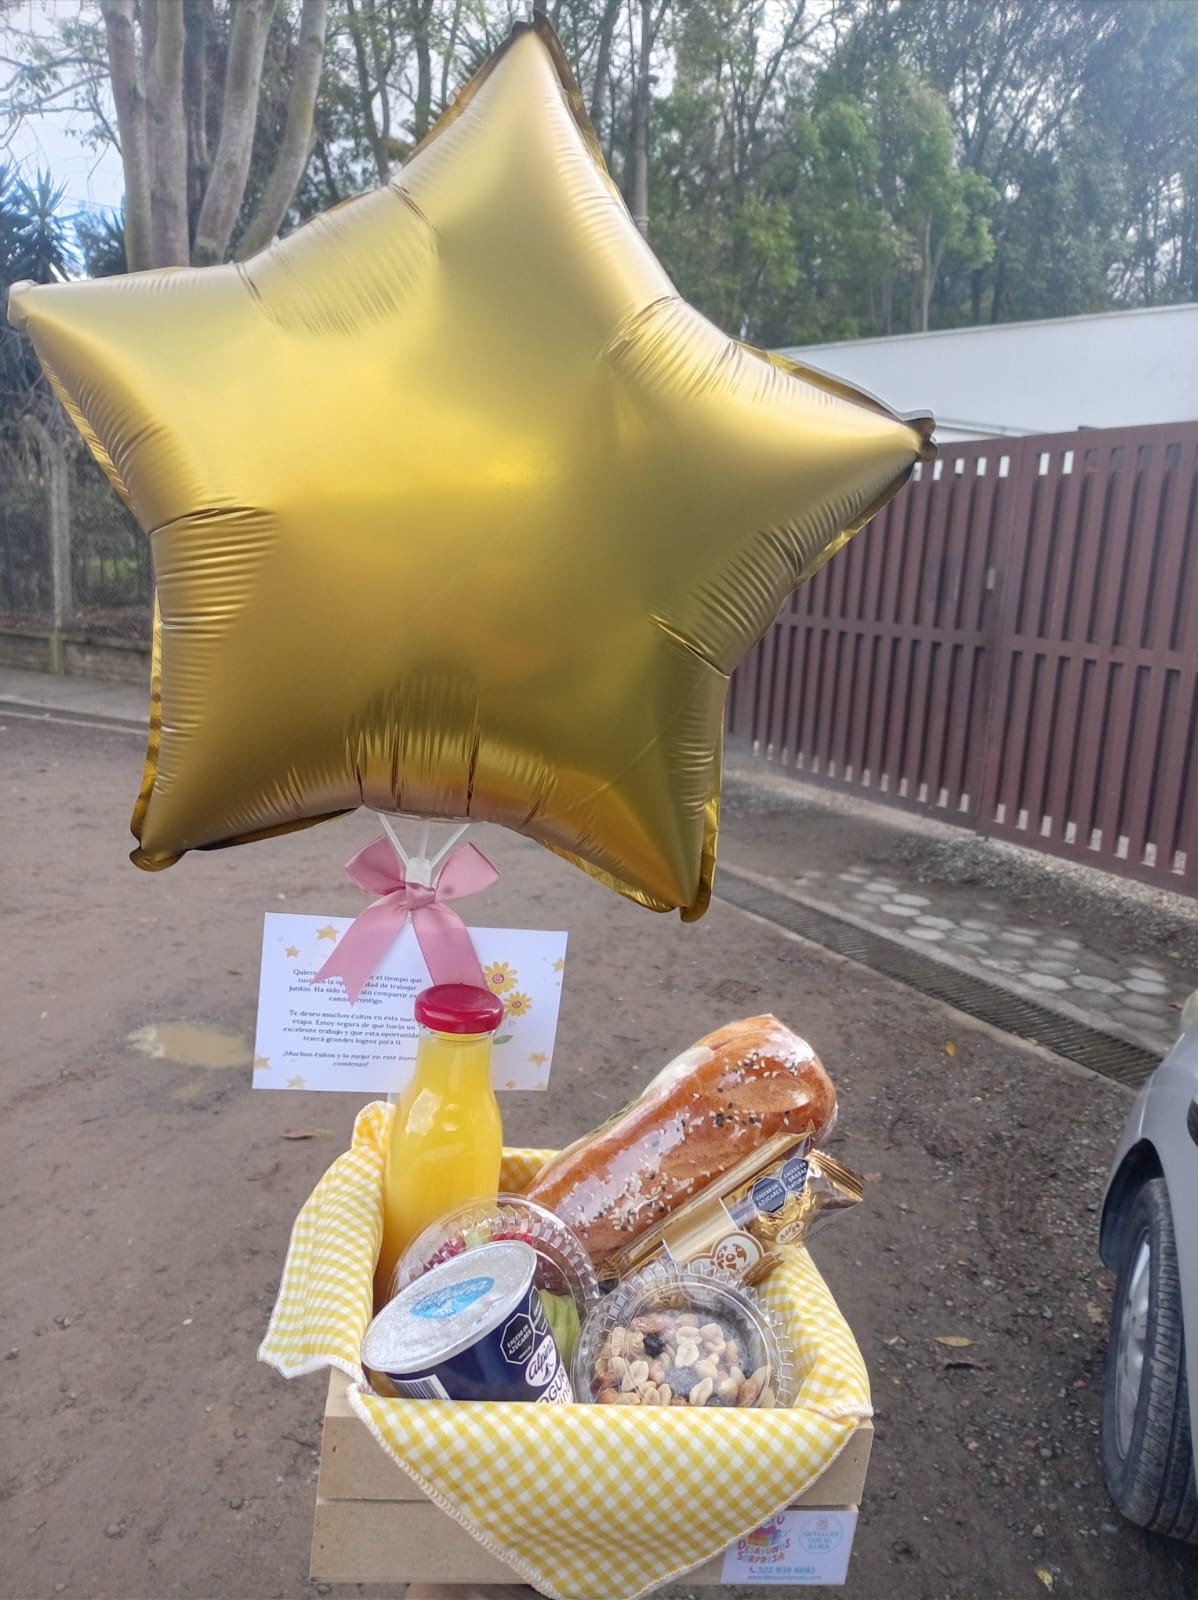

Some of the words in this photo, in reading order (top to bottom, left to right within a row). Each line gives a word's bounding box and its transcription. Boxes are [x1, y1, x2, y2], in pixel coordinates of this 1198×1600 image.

[299, 1010, 321, 1018] deseo
[321, 1011, 350, 1019] muchos
[350, 1013, 373, 1021] éxitos
[315, 1019, 335, 1027] Estoy
[336, 1020, 360, 1029] segura
[282, 1026, 318, 1034] excelente
[318, 1027, 344, 1036] trabajo
[325, 1036, 354, 1044] grandes
[355, 1037, 378, 1046] logros
[378, 1038, 395, 1047] para
